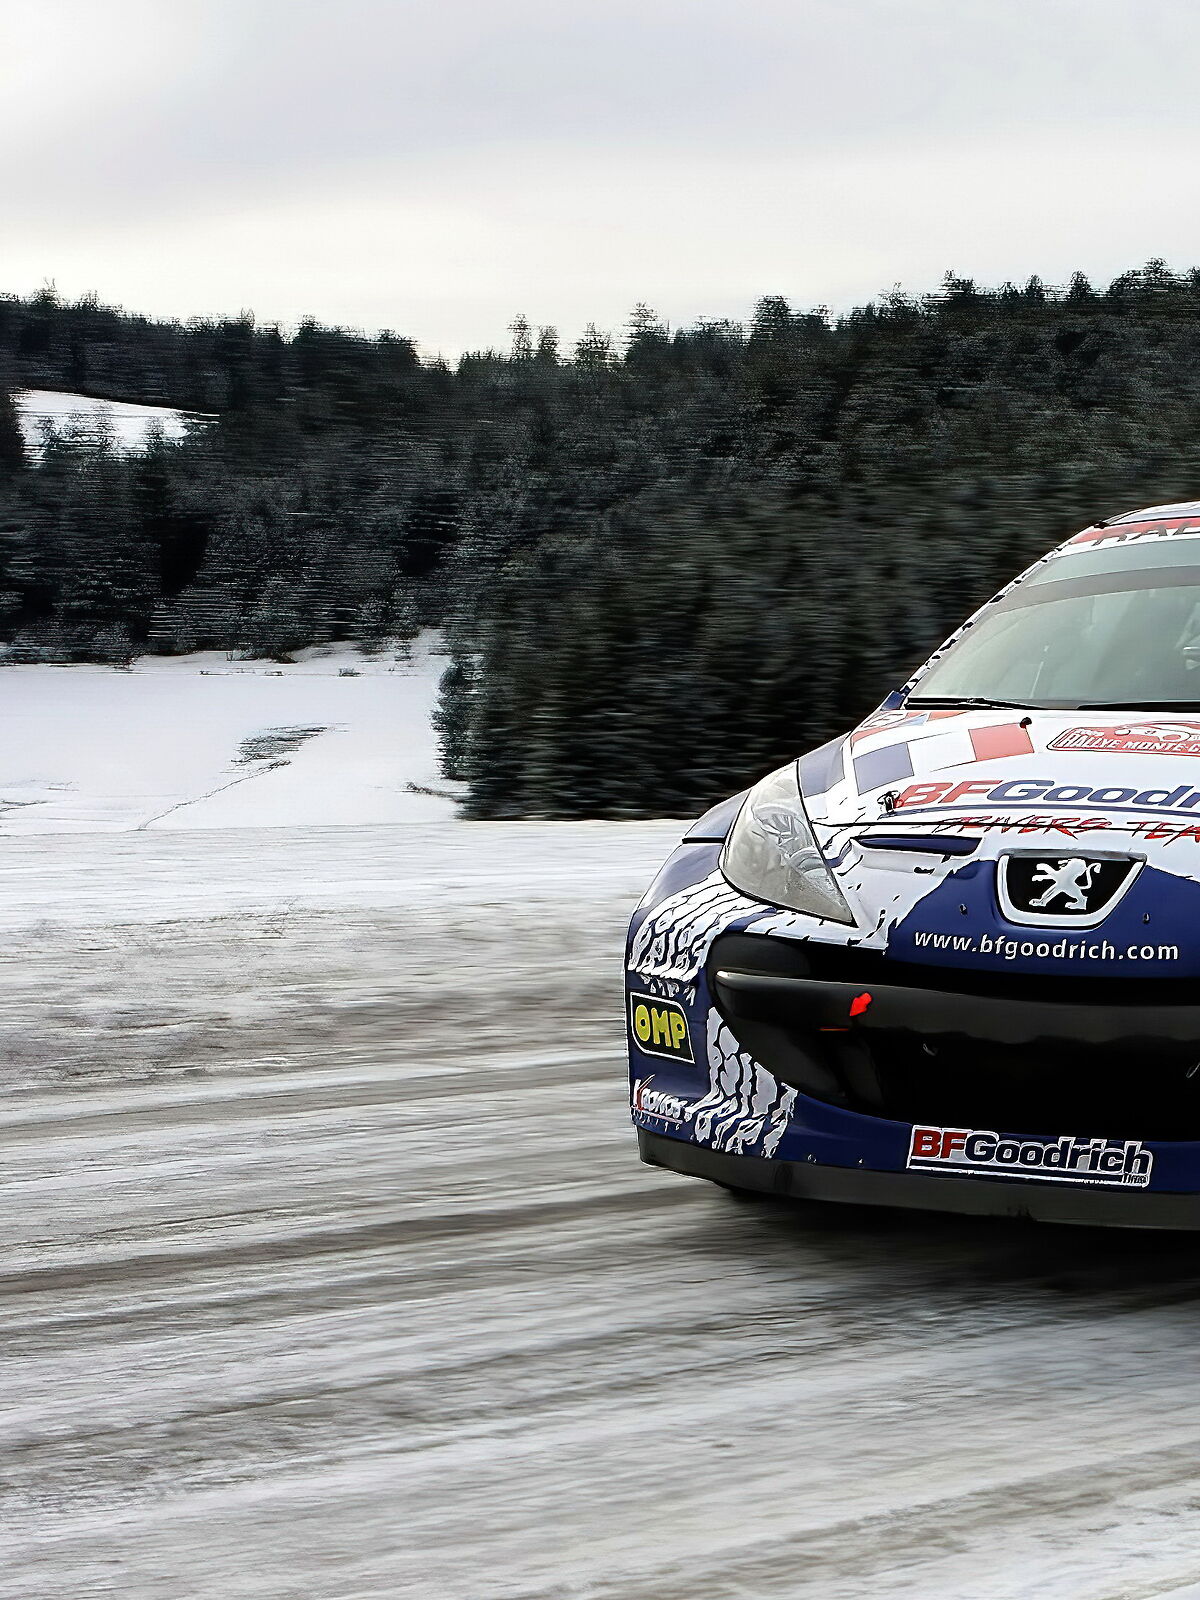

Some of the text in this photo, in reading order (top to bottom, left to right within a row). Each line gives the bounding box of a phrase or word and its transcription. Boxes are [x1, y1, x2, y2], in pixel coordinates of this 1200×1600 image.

[1058, 733, 1119, 749] RALLYE
[914, 931, 1179, 960] www.bfgoodrich.com
[635, 1004, 686, 1049] OMP
[911, 1127, 1153, 1174] BFGoodrich
